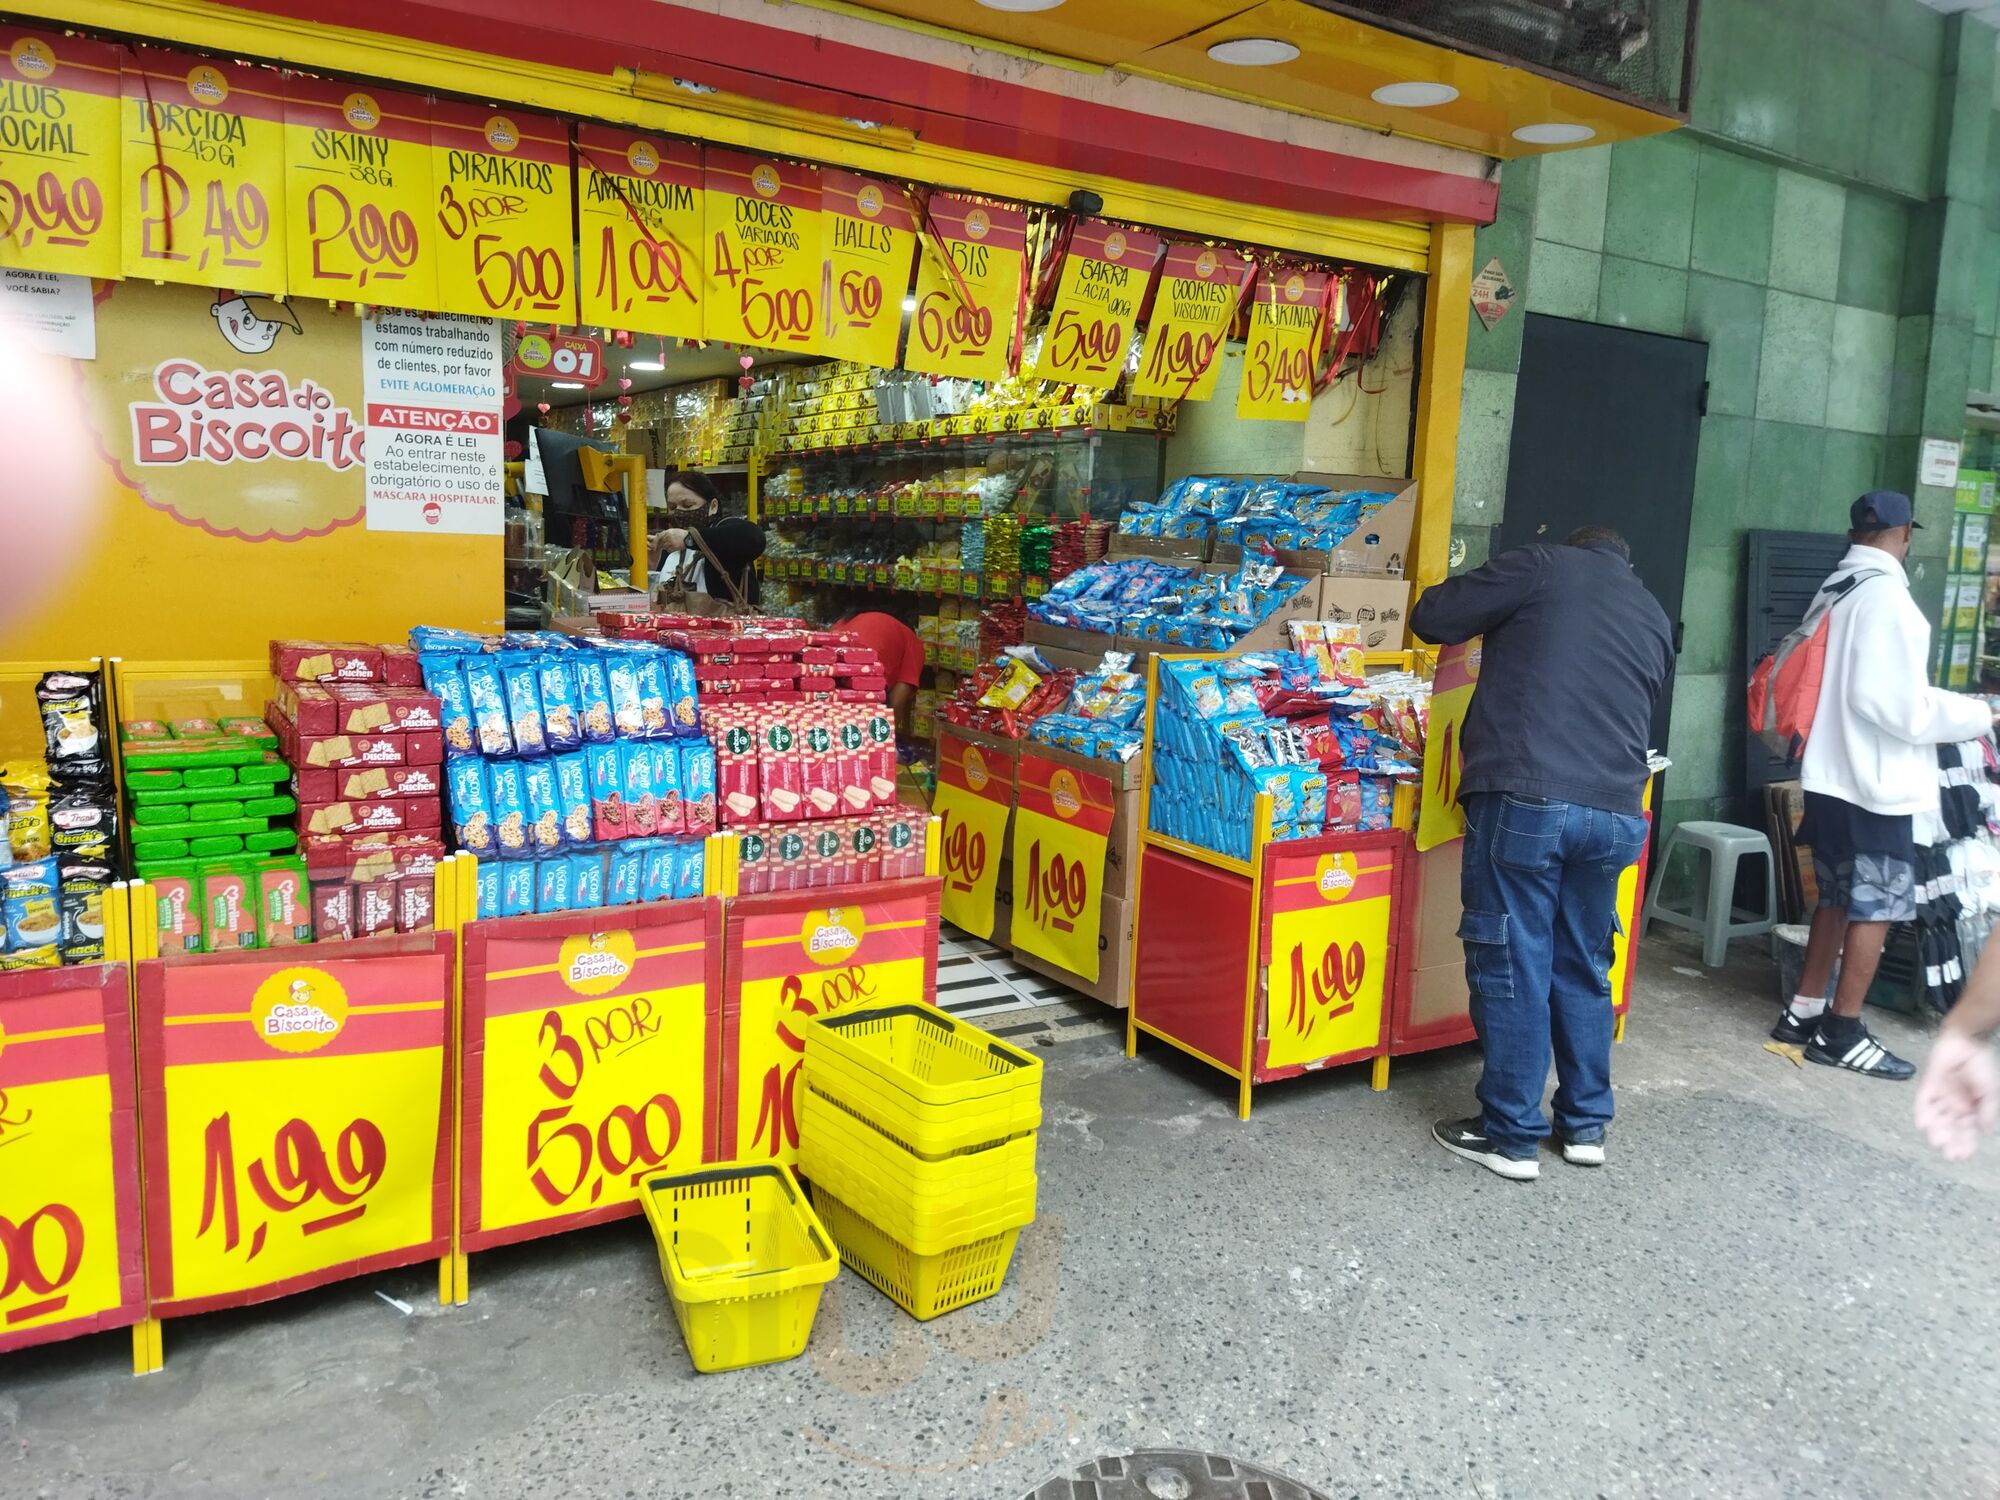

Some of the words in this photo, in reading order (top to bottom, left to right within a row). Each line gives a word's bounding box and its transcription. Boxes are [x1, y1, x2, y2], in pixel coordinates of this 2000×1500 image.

[0, 116, 88, 155] OCIAL
[132, 99, 246, 147] TORCIDA
[311, 128, 389, 168] SKINY
[350, 164, 393, 188] 38G
[449, 150, 552, 194] PIRAKIDS
[587, 170, 694, 211] AMENDOIM
[141, 164, 269, 271] 2,49
[438, 185, 467, 240] 3
[469, 195, 528, 227] POR
[735, 196, 793, 229] DOCES
[308, 184, 419, 288] 2,99
[735, 222, 800, 251] VARIADOS
[834, 217, 893, 253] HALLS
[5, 270, 36, 280] AGORA
[475, 234, 564, 311] 5,00
[596, 225, 682, 313] 1,00
[714, 230, 741, 288] 4
[743, 247, 785, 274] POR
[950, 241, 989, 277] BIS
[1080, 258, 1129, 287] BARRA
[30, 286, 61, 296] SABIA?
[1074, 280, 1110, 302] LACTA
[1172, 278, 1227, 304] COOKIES
[1472, 289, 1489, 299] 24H
[740, 278, 813, 343] 5,00
[1173, 301, 1221, 322] VISCONTI
[375, 341, 399, 352] com
[402, 341, 443, 357] número
[447, 345, 493, 360] reduzido
[376, 323, 423, 337] estamos
[426, 325, 490, 342] trabalhando
[1052, 309, 1121, 371] 5,99
[377, 358, 391, 370] de
[394, 359, 440, 374] clientes,
[443, 366, 461, 377] por
[464, 364, 491, 377] favor
[553, 349, 593, 376] 01
[158, 363, 289, 410] Casa
[293, 384, 331, 411] do
[380, 379, 409, 391] EVITE
[413, 381, 495, 398] AGLOMERAÇÃO
[379, 408, 492, 431] ATENÇÃO
[385, 445, 404, 457] Ao
[408, 449, 446, 460] entrar
[450, 451, 486, 462] neste
[394, 433, 442, 446] AGORA
[446, 434, 454, 446] É
[458, 437, 476, 447] LEI
[371, 475, 441, 489] obrigatório
[445, 479, 453, 488] o
[457, 480, 480, 490] uso
[484, 480, 500, 491] de
[374, 459, 485, 477] estabelecimento,
[489, 465, 497, 476] é
[373, 490, 426, 501] MÁSCARA
[430, 493, 499, 504] HOSPITALAR.
[338, 669, 373, 678] Duchen
[401, 719, 438, 728] Duchen
[1304, 724, 1328, 735] Doritos
[363, 752, 401, 761] Duchen
[606, 749, 618, 787] Visconti
[664, 749, 676, 785] Visconti
[700, 753, 712, 789] Visconti
[398, 782, 435, 791] Duchen
[466, 767, 482, 806] Visconti
[504, 768, 519, 806] Visconti
[538, 768, 553, 806] Visconti
[570, 761, 585, 800] Visconti
[364, 817, 401, 826] Duchen
[405, 866, 435, 875] Duche
[519, 867, 530, 906] Visconti
[555, 865, 567, 902] Visconti
[589, 865, 600, 902] Visconti
[626, 859, 638, 895] Visconti
[661, 853, 672, 889] Visconti
[1025, 838, 1086, 932] 1,99
[1322, 877, 1352, 889] Biscoito
[223, 885, 240, 932] Marilan
[278, 879, 295, 926] Marilan
[405, 888, 415, 928] Duchen
[486, 872, 497, 911] Visconti
[168, 887, 186, 935] Marilan
[366, 890, 377, 931] Duchen
[812, 934, 856, 951] Biscoito
[817, 927, 839, 938] Casa
[572, 961, 626, 980] Biscoito
[577, 954, 605, 966] Casa
[775, 975, 818, 1053] 3
[822, 965, 878, 1012] POR
[1284, 941, 1366, 1042] 1,99
[268, 1016, 335, 1033] Biscoito
[274, 1006, 309, 1018] Casa
[538, 1010, 584, 1100] 3
[585, 998, 662, 1063] POR
[526, 1094, 682, 1206] 5,00
[197, 1112, 386, 1263] 1,99
